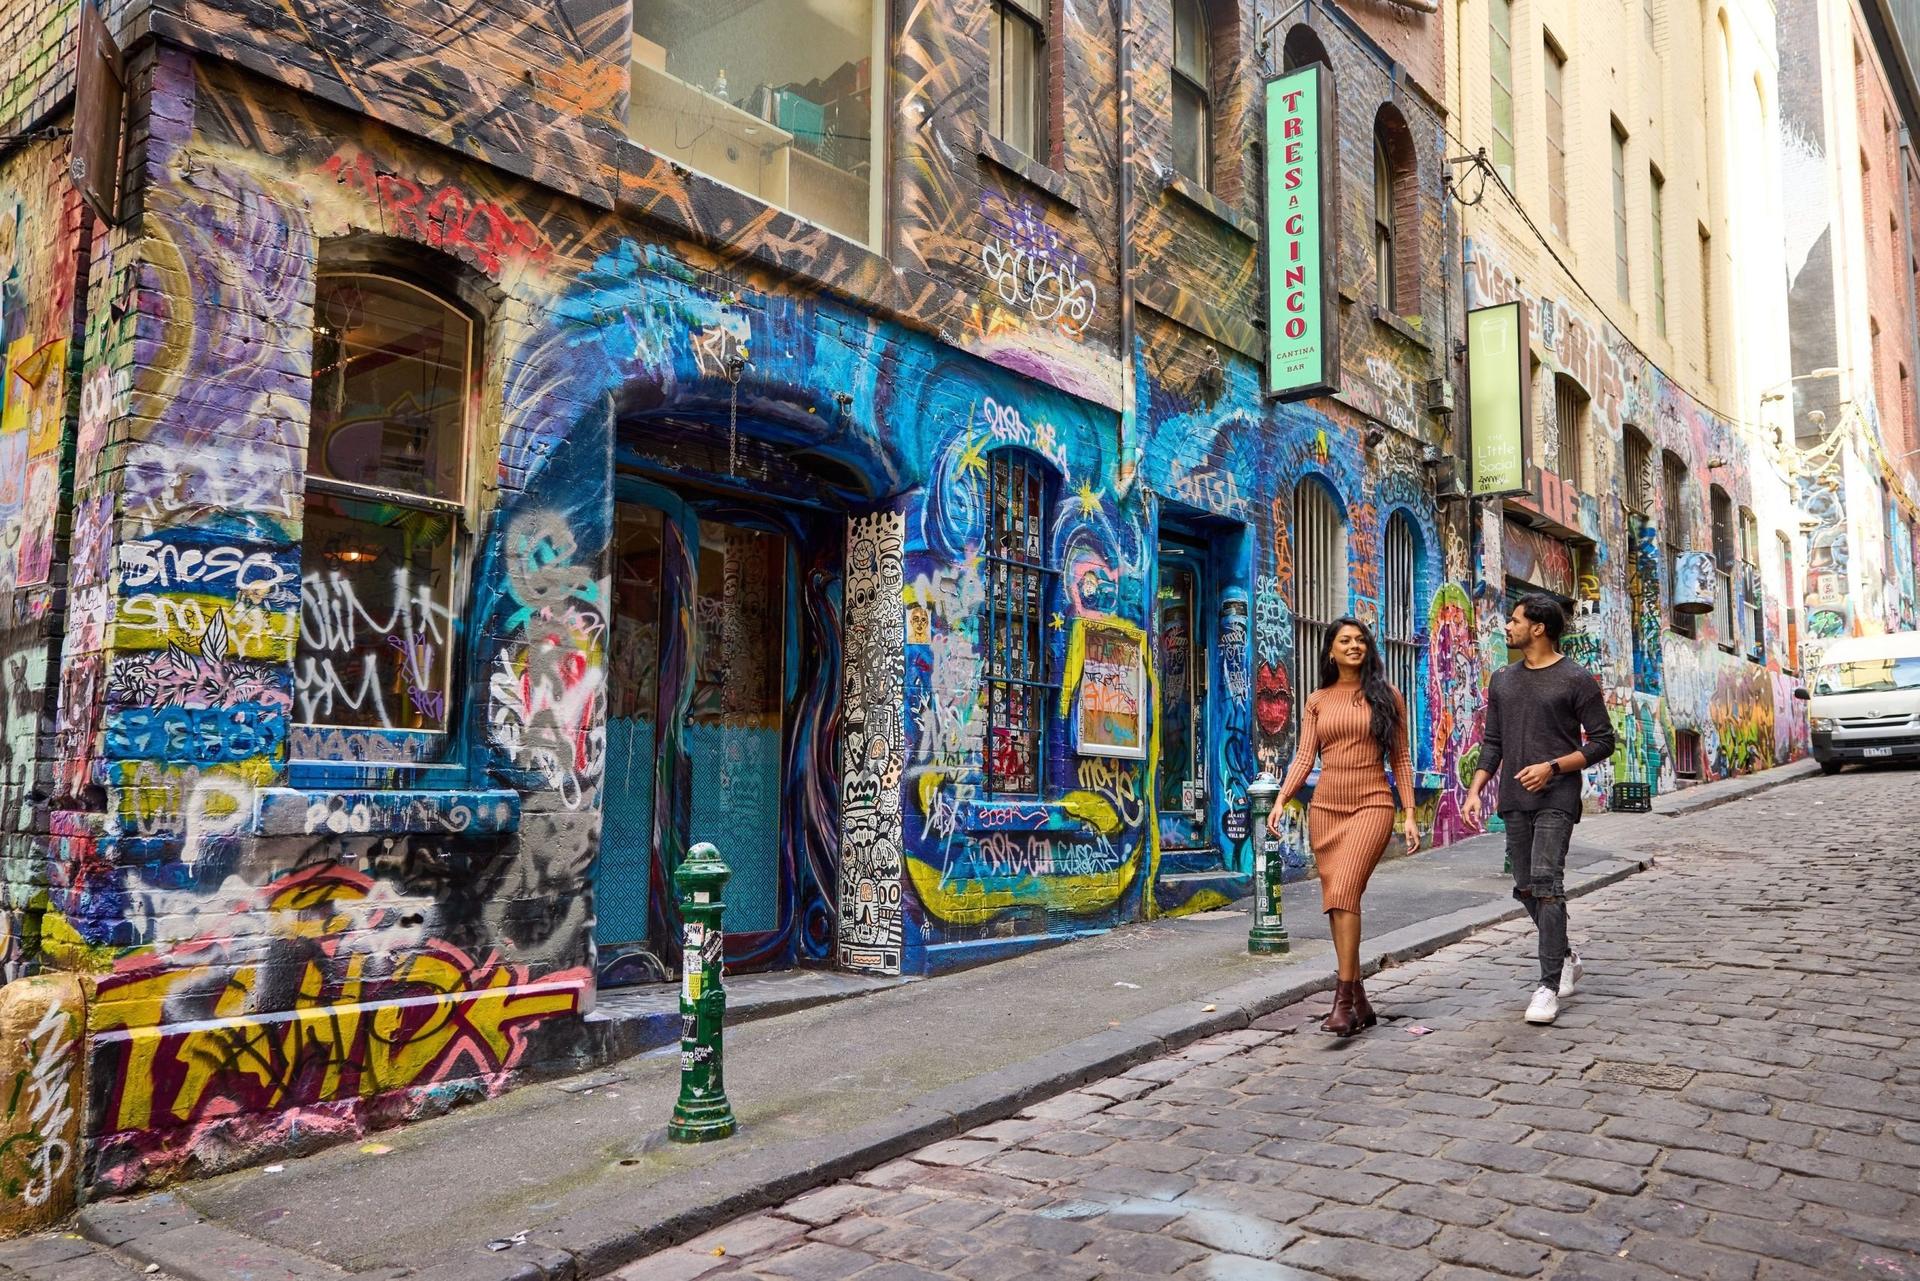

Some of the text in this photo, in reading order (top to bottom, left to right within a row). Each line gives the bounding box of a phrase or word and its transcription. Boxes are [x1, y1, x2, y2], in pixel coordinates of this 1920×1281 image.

[1282, 90, 1306, 340] TRES A CINCO
[1276, 345, 1315, 360] CANTINA
[1287, 363, 1305, 373] BAR
[1478, 441, 1516, 459] Little
[1479, 455, 1516, 473] Social
